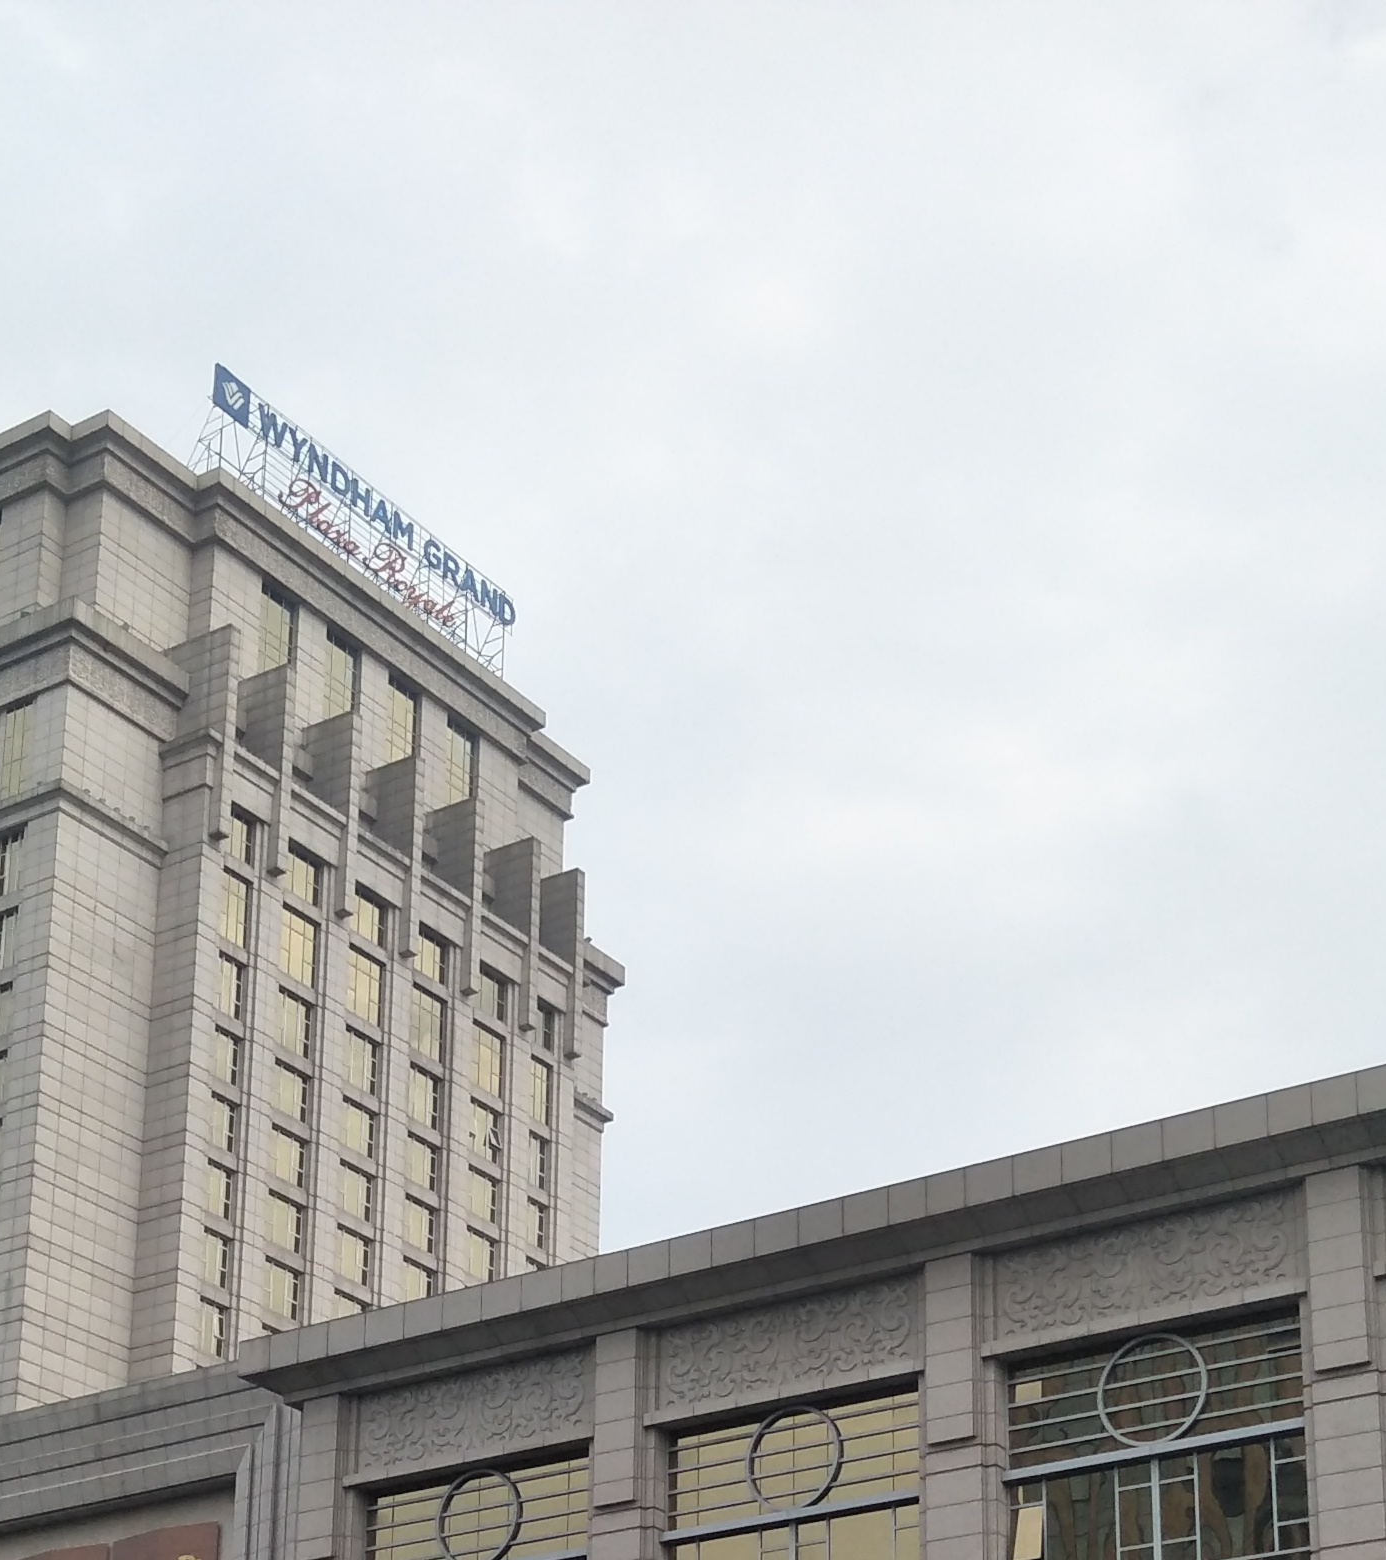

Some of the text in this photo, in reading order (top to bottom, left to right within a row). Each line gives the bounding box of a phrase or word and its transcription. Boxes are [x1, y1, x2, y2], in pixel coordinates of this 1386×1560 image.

[258, 402, 516, 626] WYNDHAM GRAND
[278, 479, 456, 627] Plaza Royale
